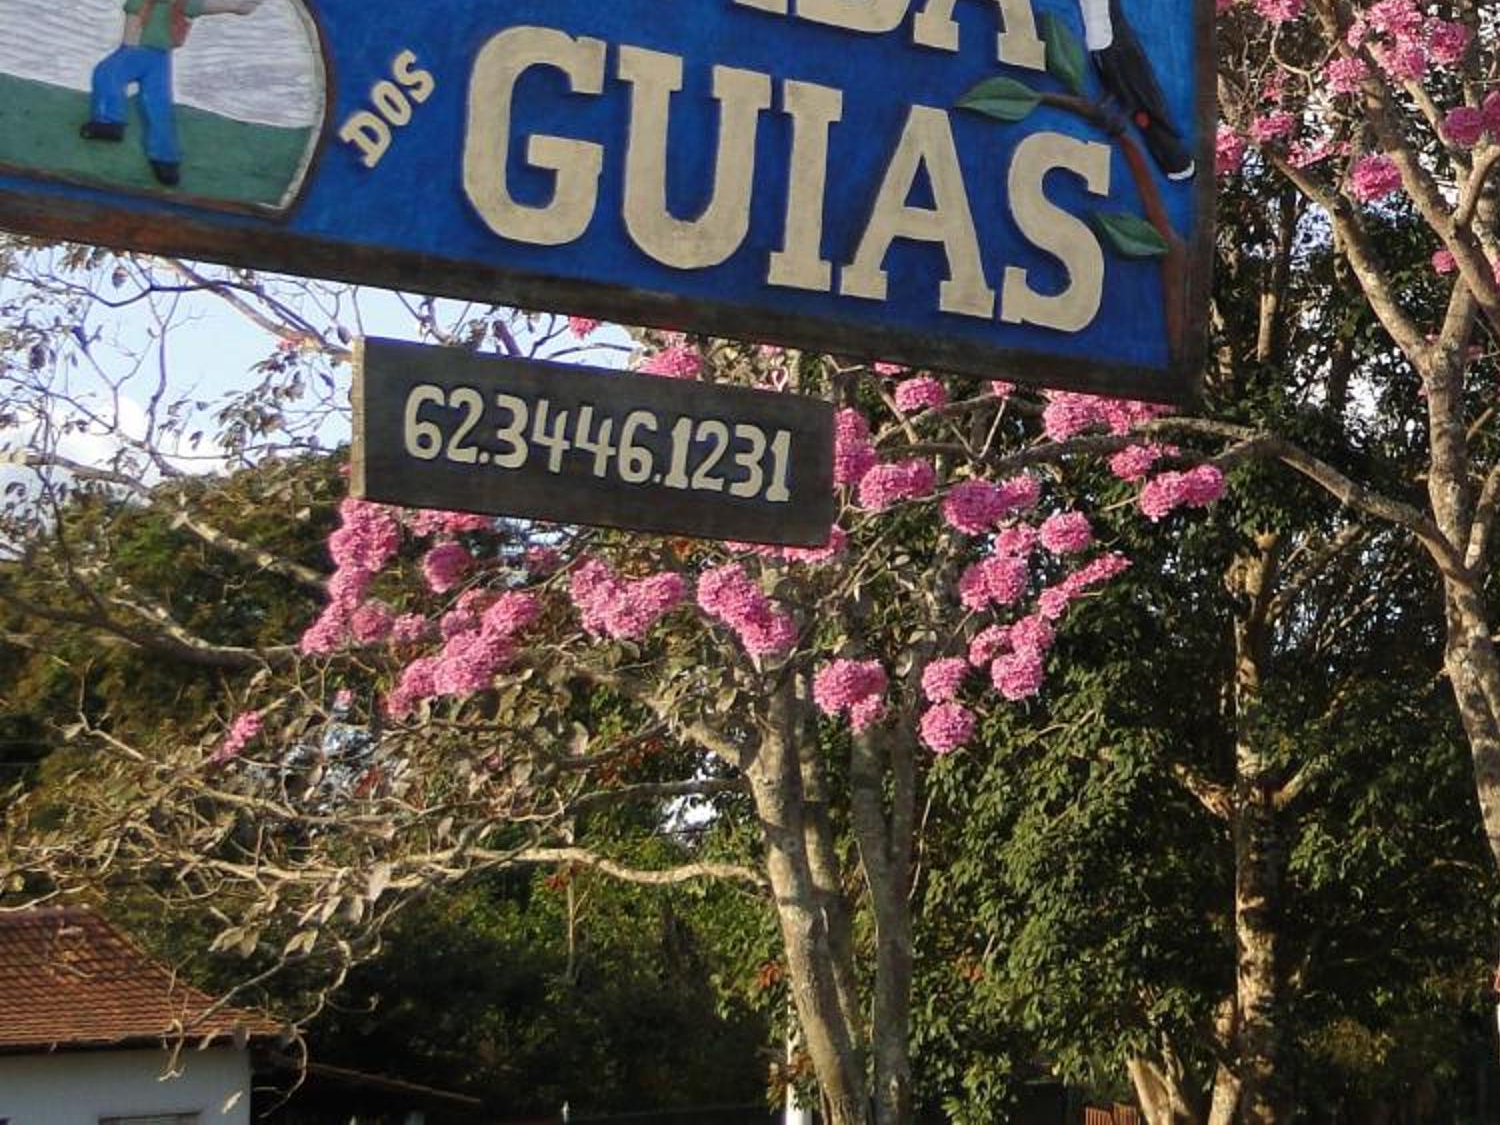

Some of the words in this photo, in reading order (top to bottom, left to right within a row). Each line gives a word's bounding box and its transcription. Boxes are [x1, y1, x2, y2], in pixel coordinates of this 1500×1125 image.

[339, 49, 435, 168] DOS
[463, 25, 1112, 333] GUIAS
[404, 384, 792, 503] 62.3446.1231
